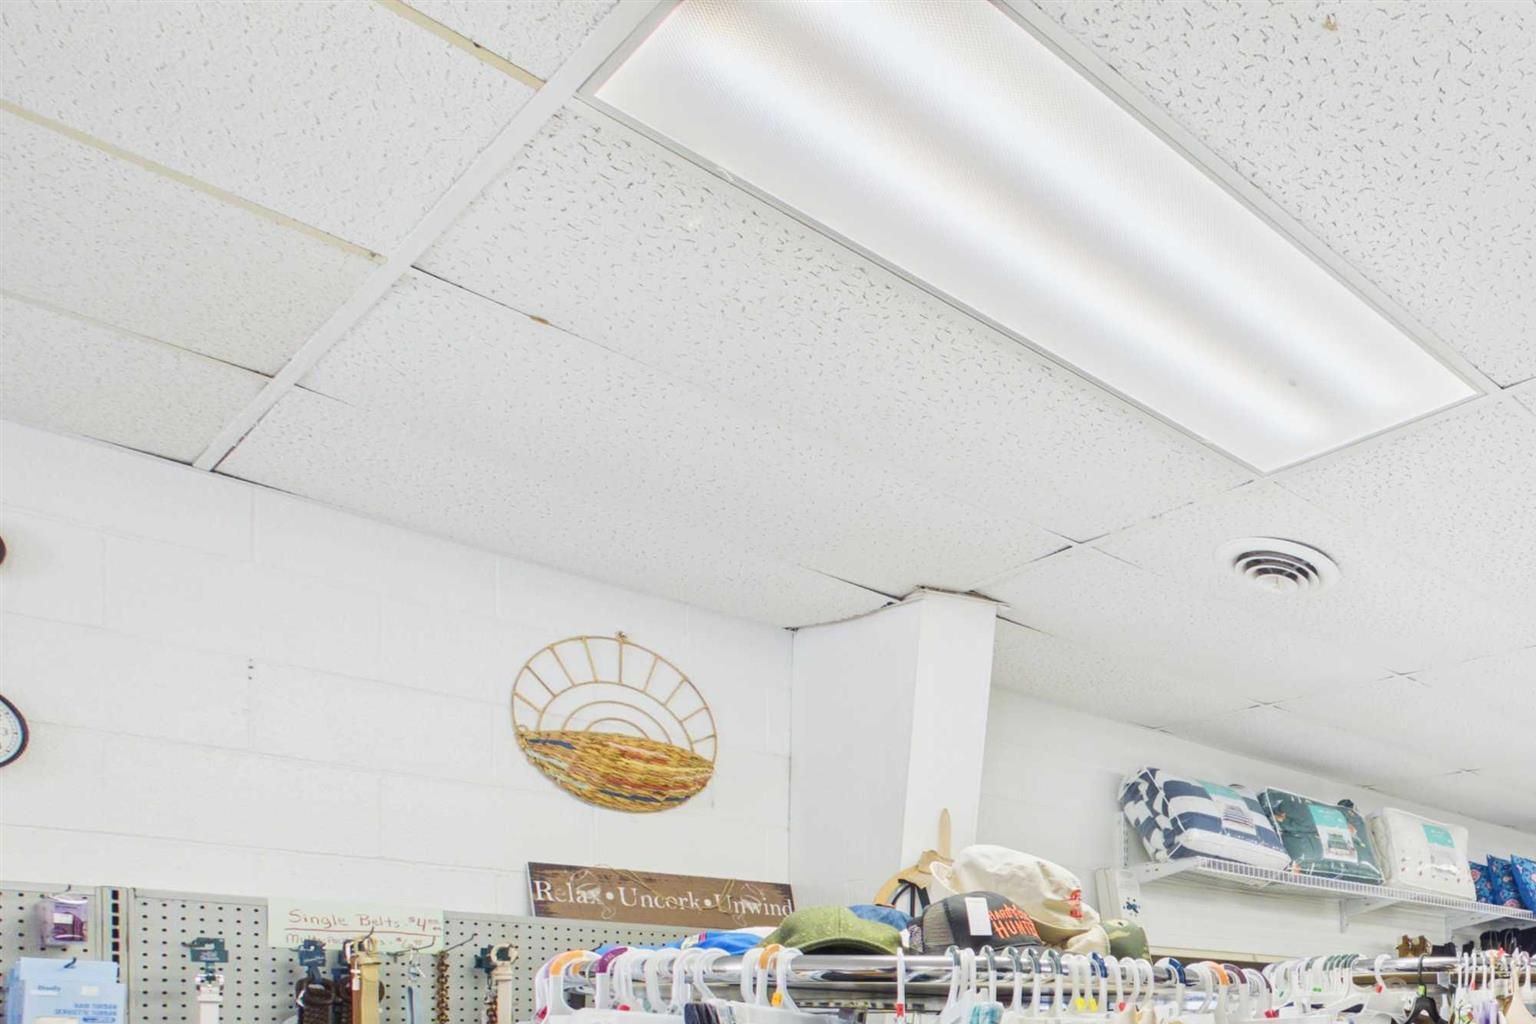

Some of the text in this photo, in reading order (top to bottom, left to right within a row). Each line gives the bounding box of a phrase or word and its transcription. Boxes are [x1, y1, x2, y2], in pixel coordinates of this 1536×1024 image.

[533, 880, 794, 917] Relax Uncork Unwind
[288, 909, 349, 929] Single
